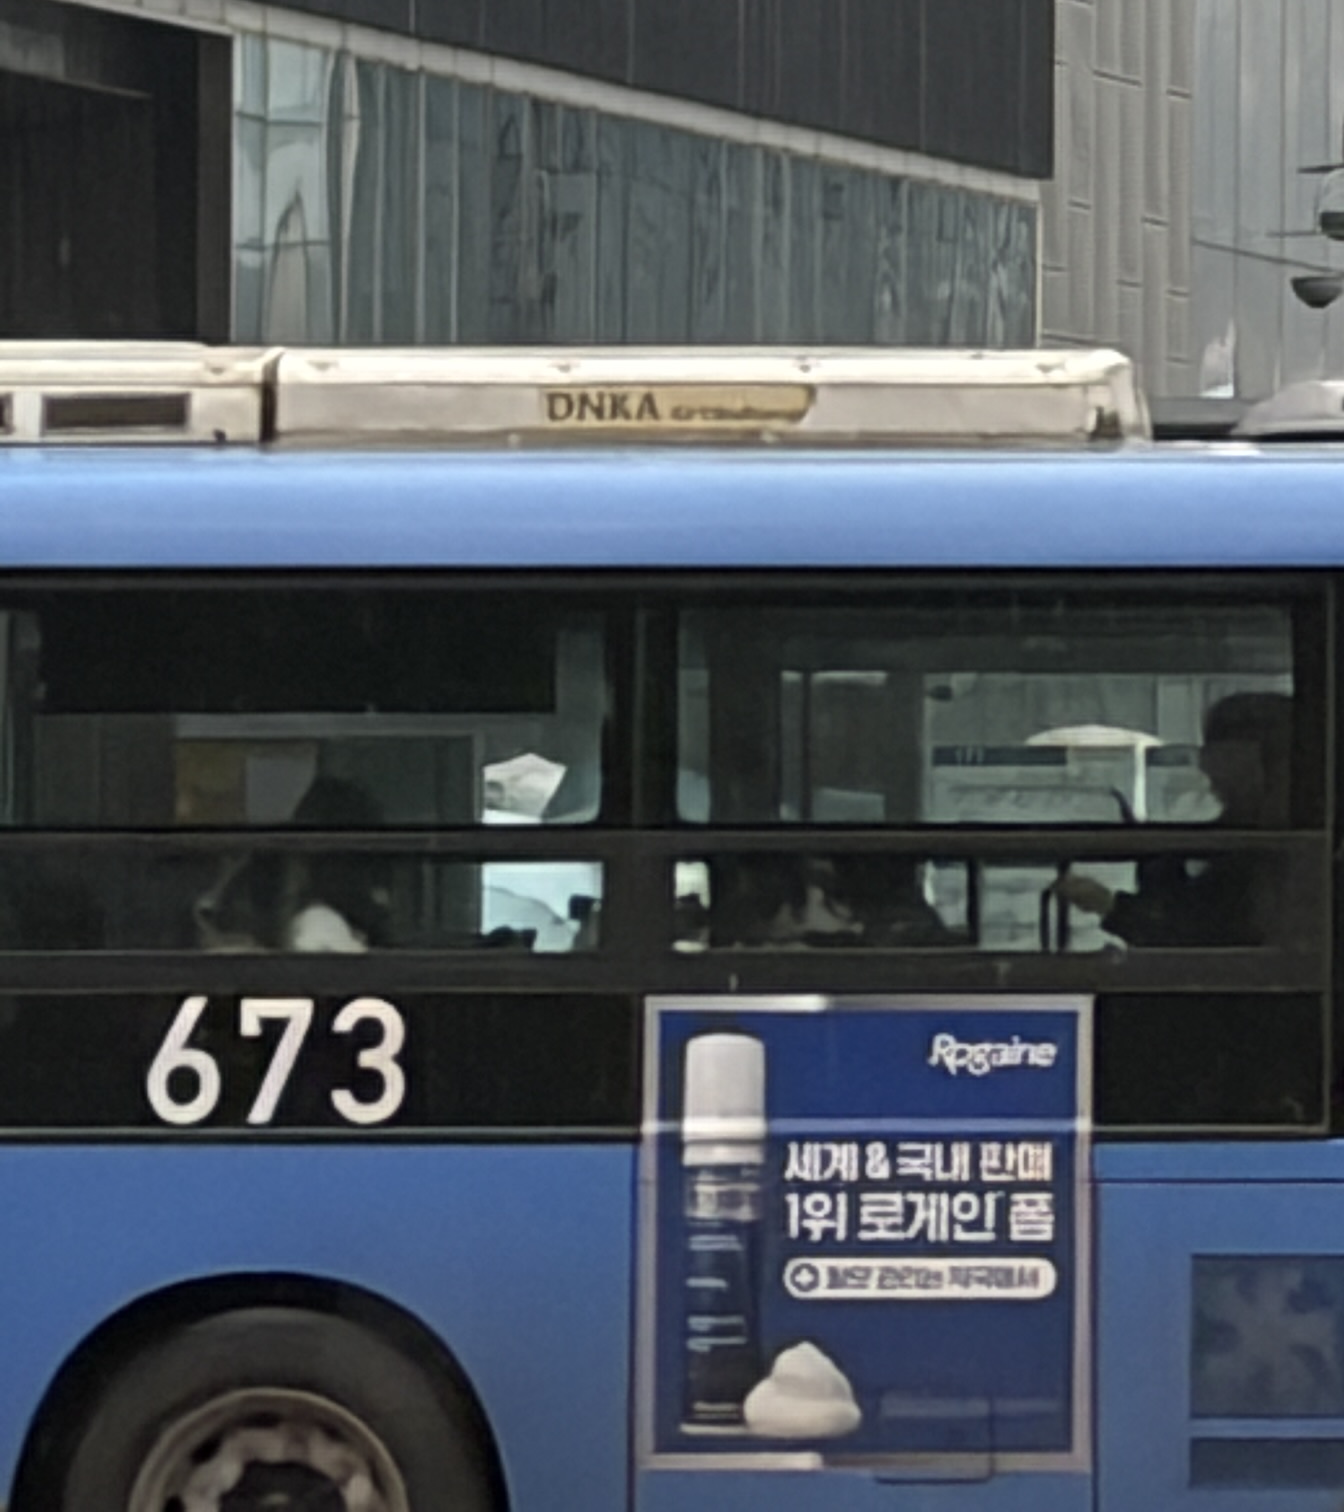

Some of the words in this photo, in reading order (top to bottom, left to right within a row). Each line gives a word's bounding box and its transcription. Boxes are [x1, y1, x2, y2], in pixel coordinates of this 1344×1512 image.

[546, 391, 661, 421] DNKA
[145, 995, 407, 1125] 673
[927, 1033, 1057, 1076] Rogaine
[784, 1141, 859, 1181] 세계
[865, 1142, 890, 1179] &
[896, 1141, 970, 1181] 국내
[979, 1141, 1053, 1181] 판매
[785, 1191, 848, 1242] 1위
[857, 1191, 1000, 1242] 로게인
[1009, 1191, 1055, 1242] 폼
